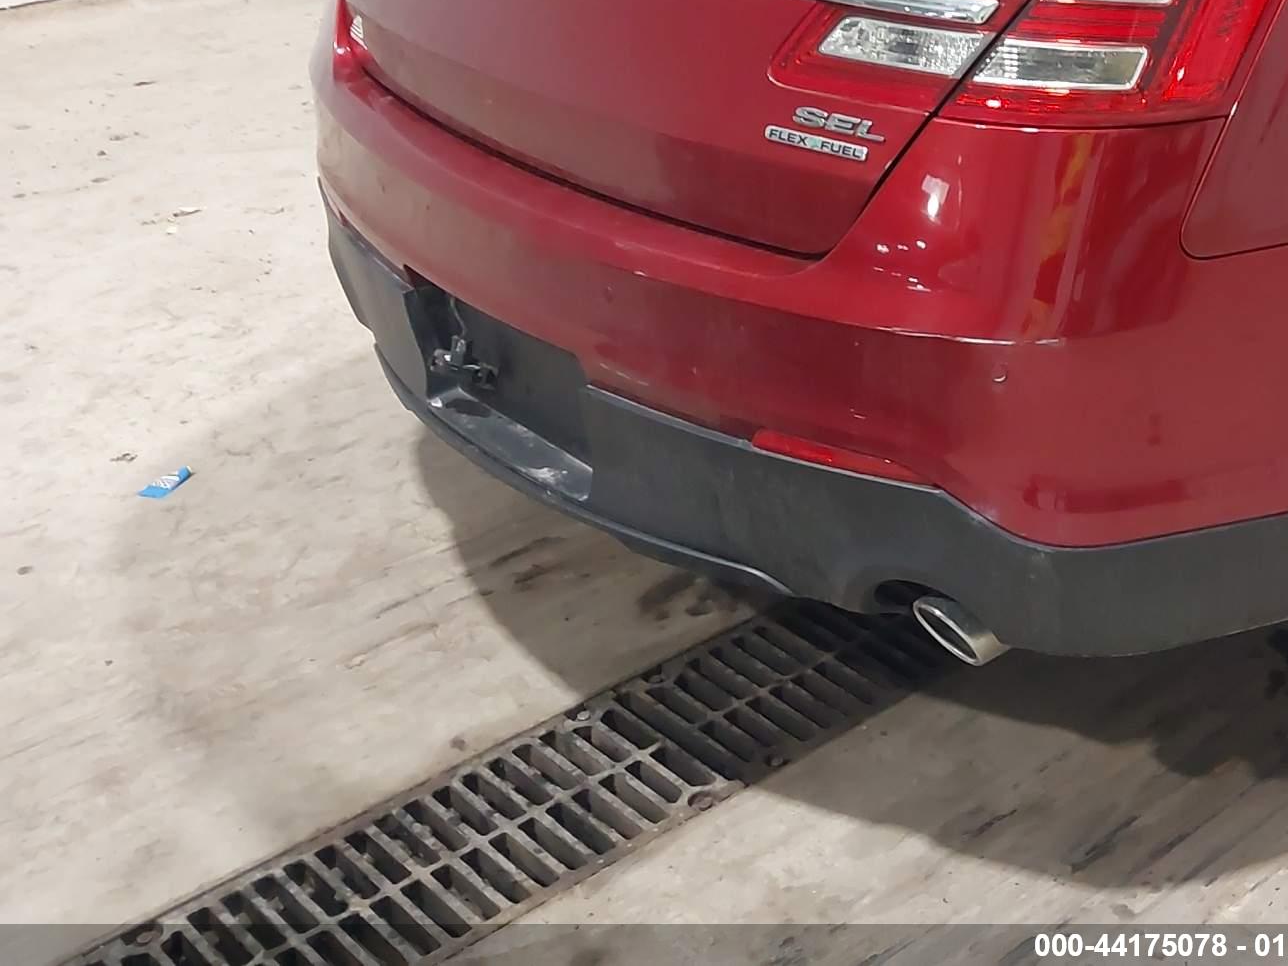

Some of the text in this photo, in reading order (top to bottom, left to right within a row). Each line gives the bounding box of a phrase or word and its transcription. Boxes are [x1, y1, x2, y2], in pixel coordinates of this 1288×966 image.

[792, 107, 885, 142] SEL
[769, 129, 864, 159] FLEX FUEL
